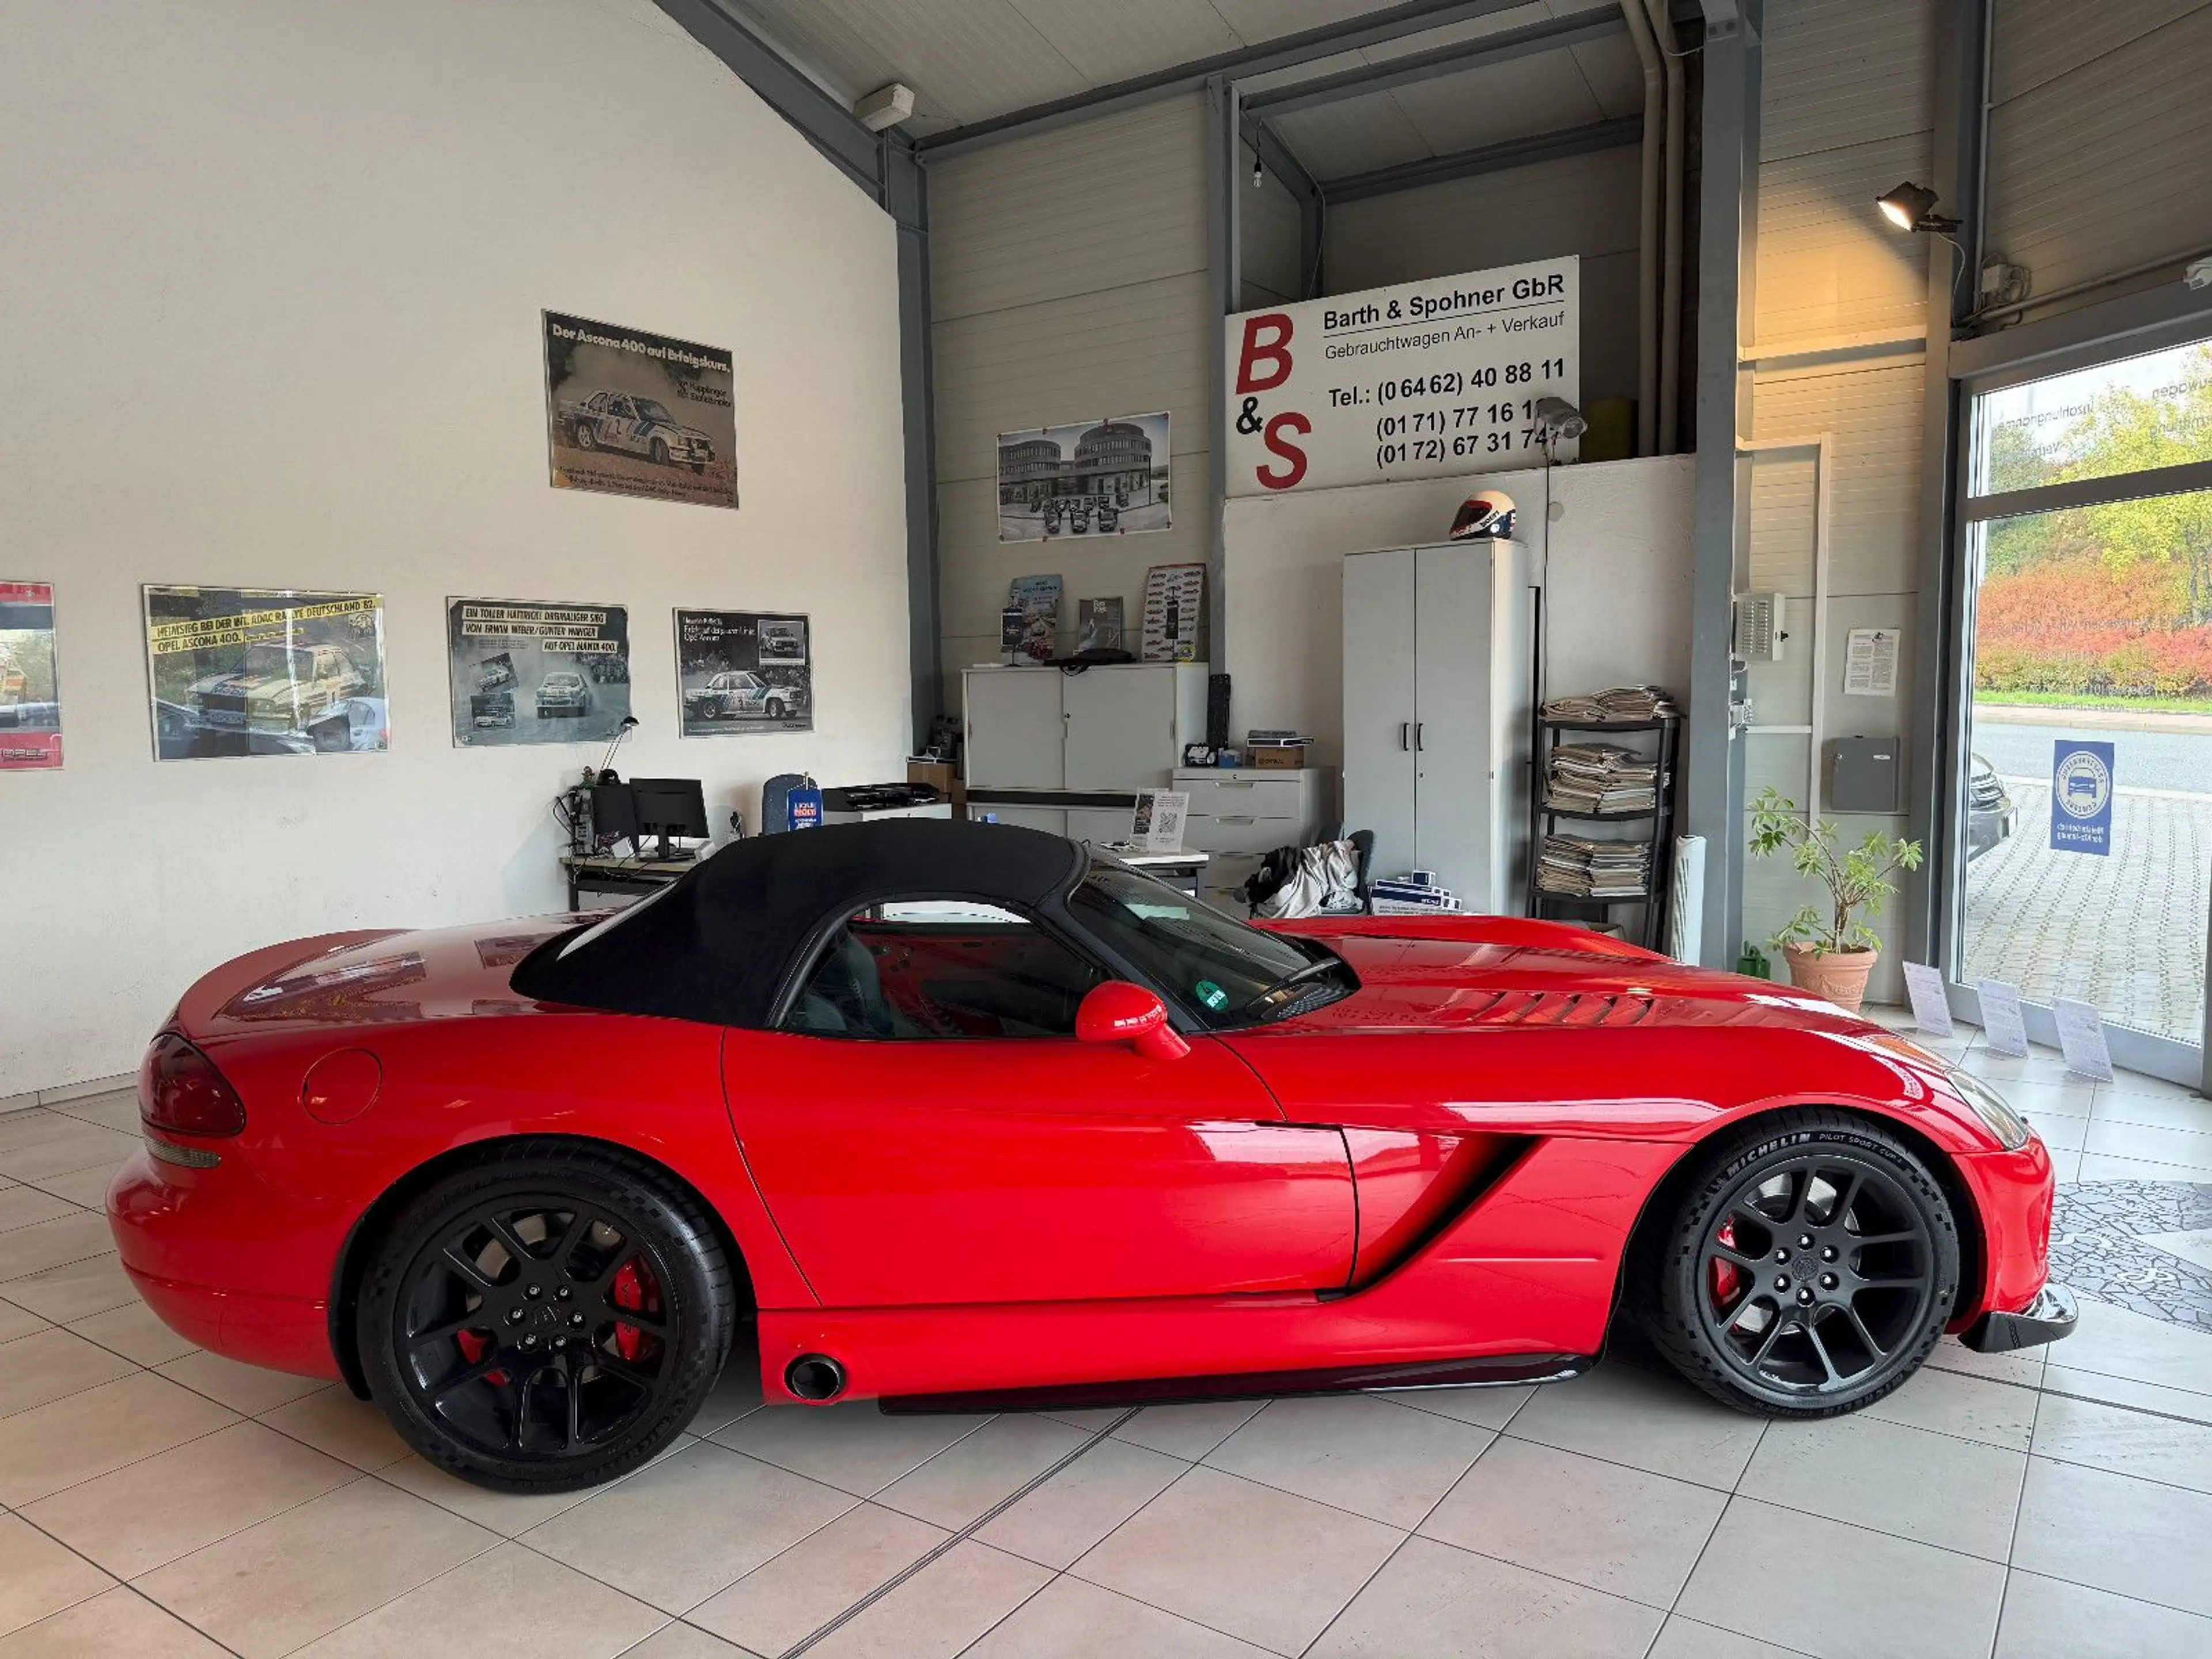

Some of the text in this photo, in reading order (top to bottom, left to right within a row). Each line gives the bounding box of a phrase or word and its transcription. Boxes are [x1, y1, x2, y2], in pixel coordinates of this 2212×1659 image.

[1324, 274, 1565, 330] Barth & Spohner GbR
[553, 324, 575, 339] Der
[577, 329, 620, 349] Ascona
[621, 339, 646, 353] 400
[647, 347, 666, 359] auf
[1325, 311, 1565, 359] Gebrauchtwagen An- + Verkauf
[1236, 313, 1293, 395] B
[1328, 387, 1370, 407] Tel.:
[1471, 368, 1497, 388] 40
[1505, 362, 1532, 384] 88
[1541, 358, 1564, 380] 11
[1236, 396, 1263, 435] &
[1453, 406, 1479, 428] 77
[1487, 402, 1513, 423] 16
[1256, 412, 1312, 490] S
[1453, 435, 1479, 457] 67
[1487, 431, 1510, 453] 31
[215, 618, 232, 629] DER
[275, 608, 304, 623] RALYE
[307, 601, 361, 618] DEUTSCHLAND
[465, 607, 478, 618] EIN
[465, 623, 482, 632] VON
[158, 641, 180, 653] OPEL
[183, 636, 218, 649] ASCONA
[1726, 1132, 1811, 1177] MICHELIN
[1819, 1133, 1846, 1141] PILOT
[1849, 1137, 1878, 1150] SPORT
